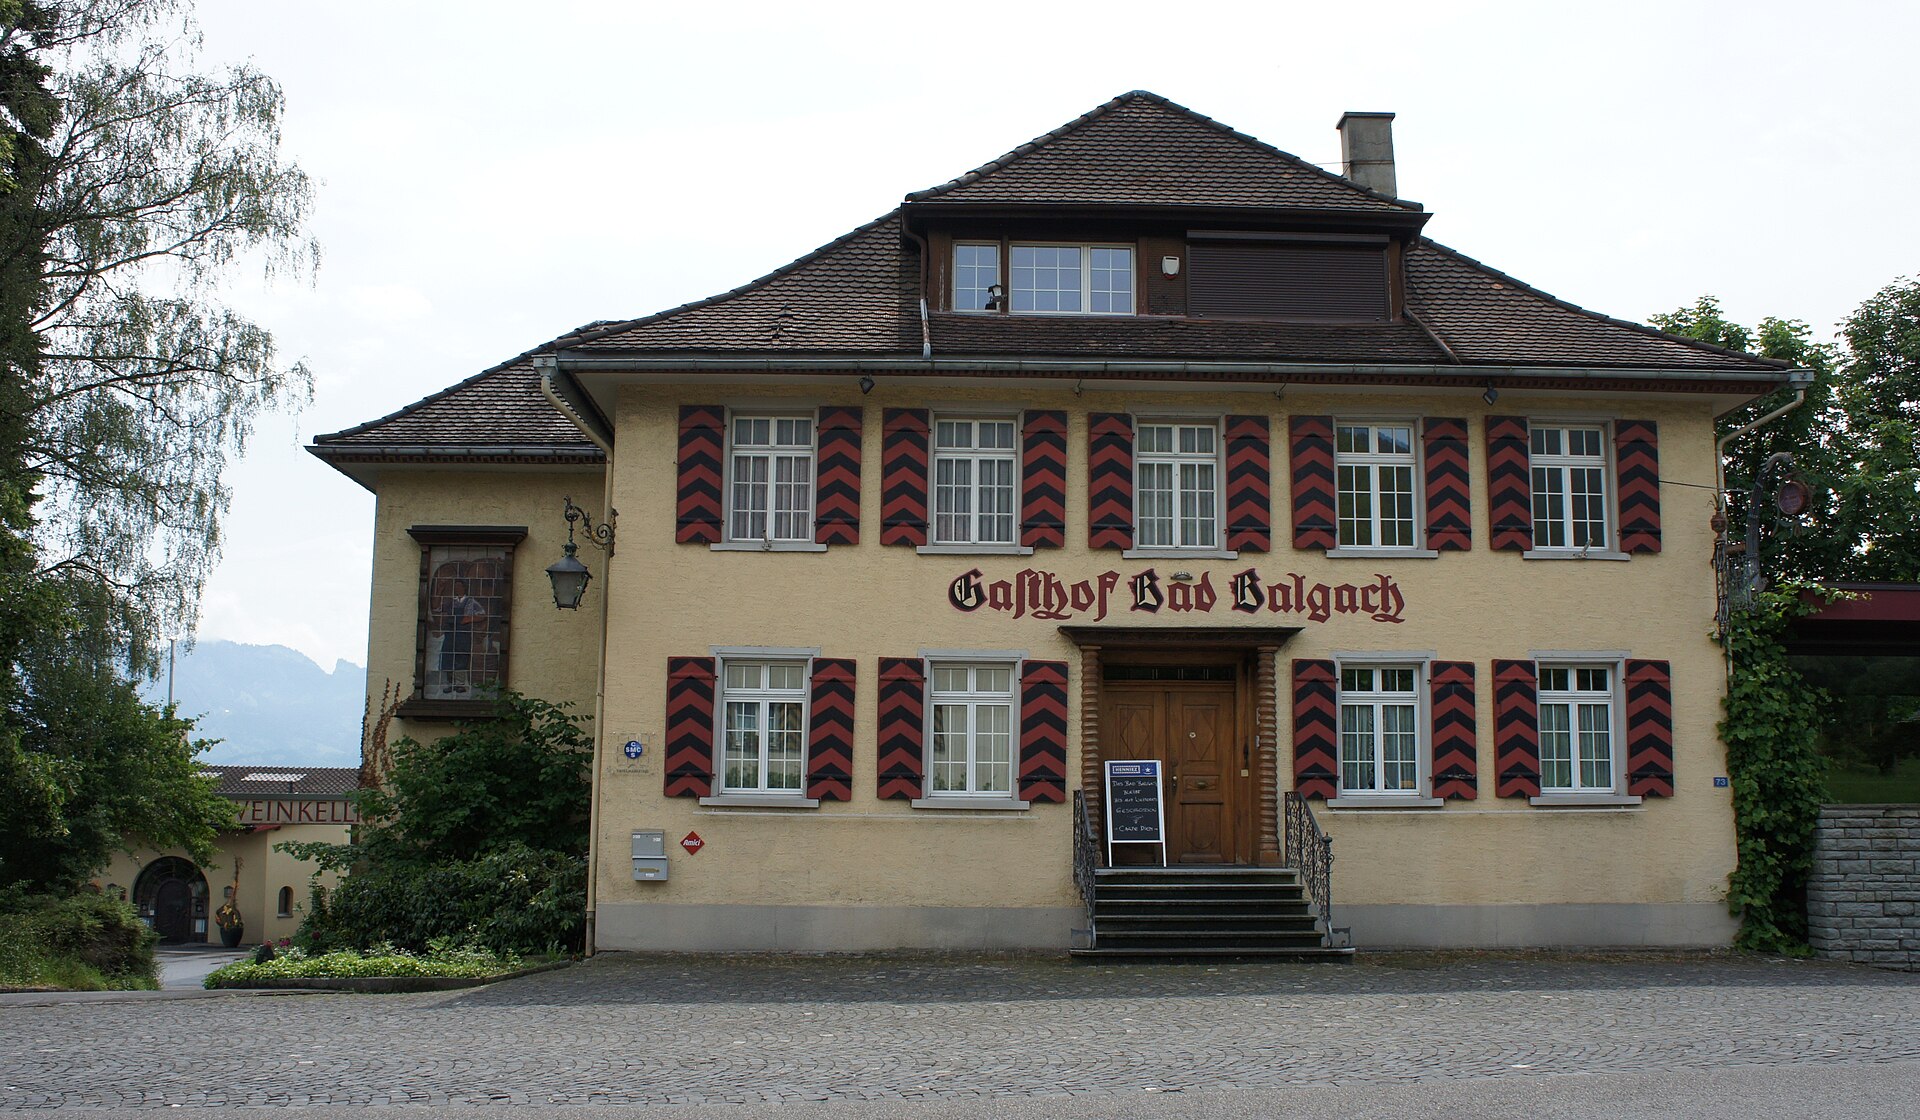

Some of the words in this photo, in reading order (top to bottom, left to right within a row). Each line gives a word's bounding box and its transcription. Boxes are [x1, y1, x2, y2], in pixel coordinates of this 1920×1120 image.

[1127, 567, 1218, 614] Bad
[1229, 567, 1406, 624] Balgach
[1715, 778, 1726, 786] 73
[682, 839, 701, 847] Amici
